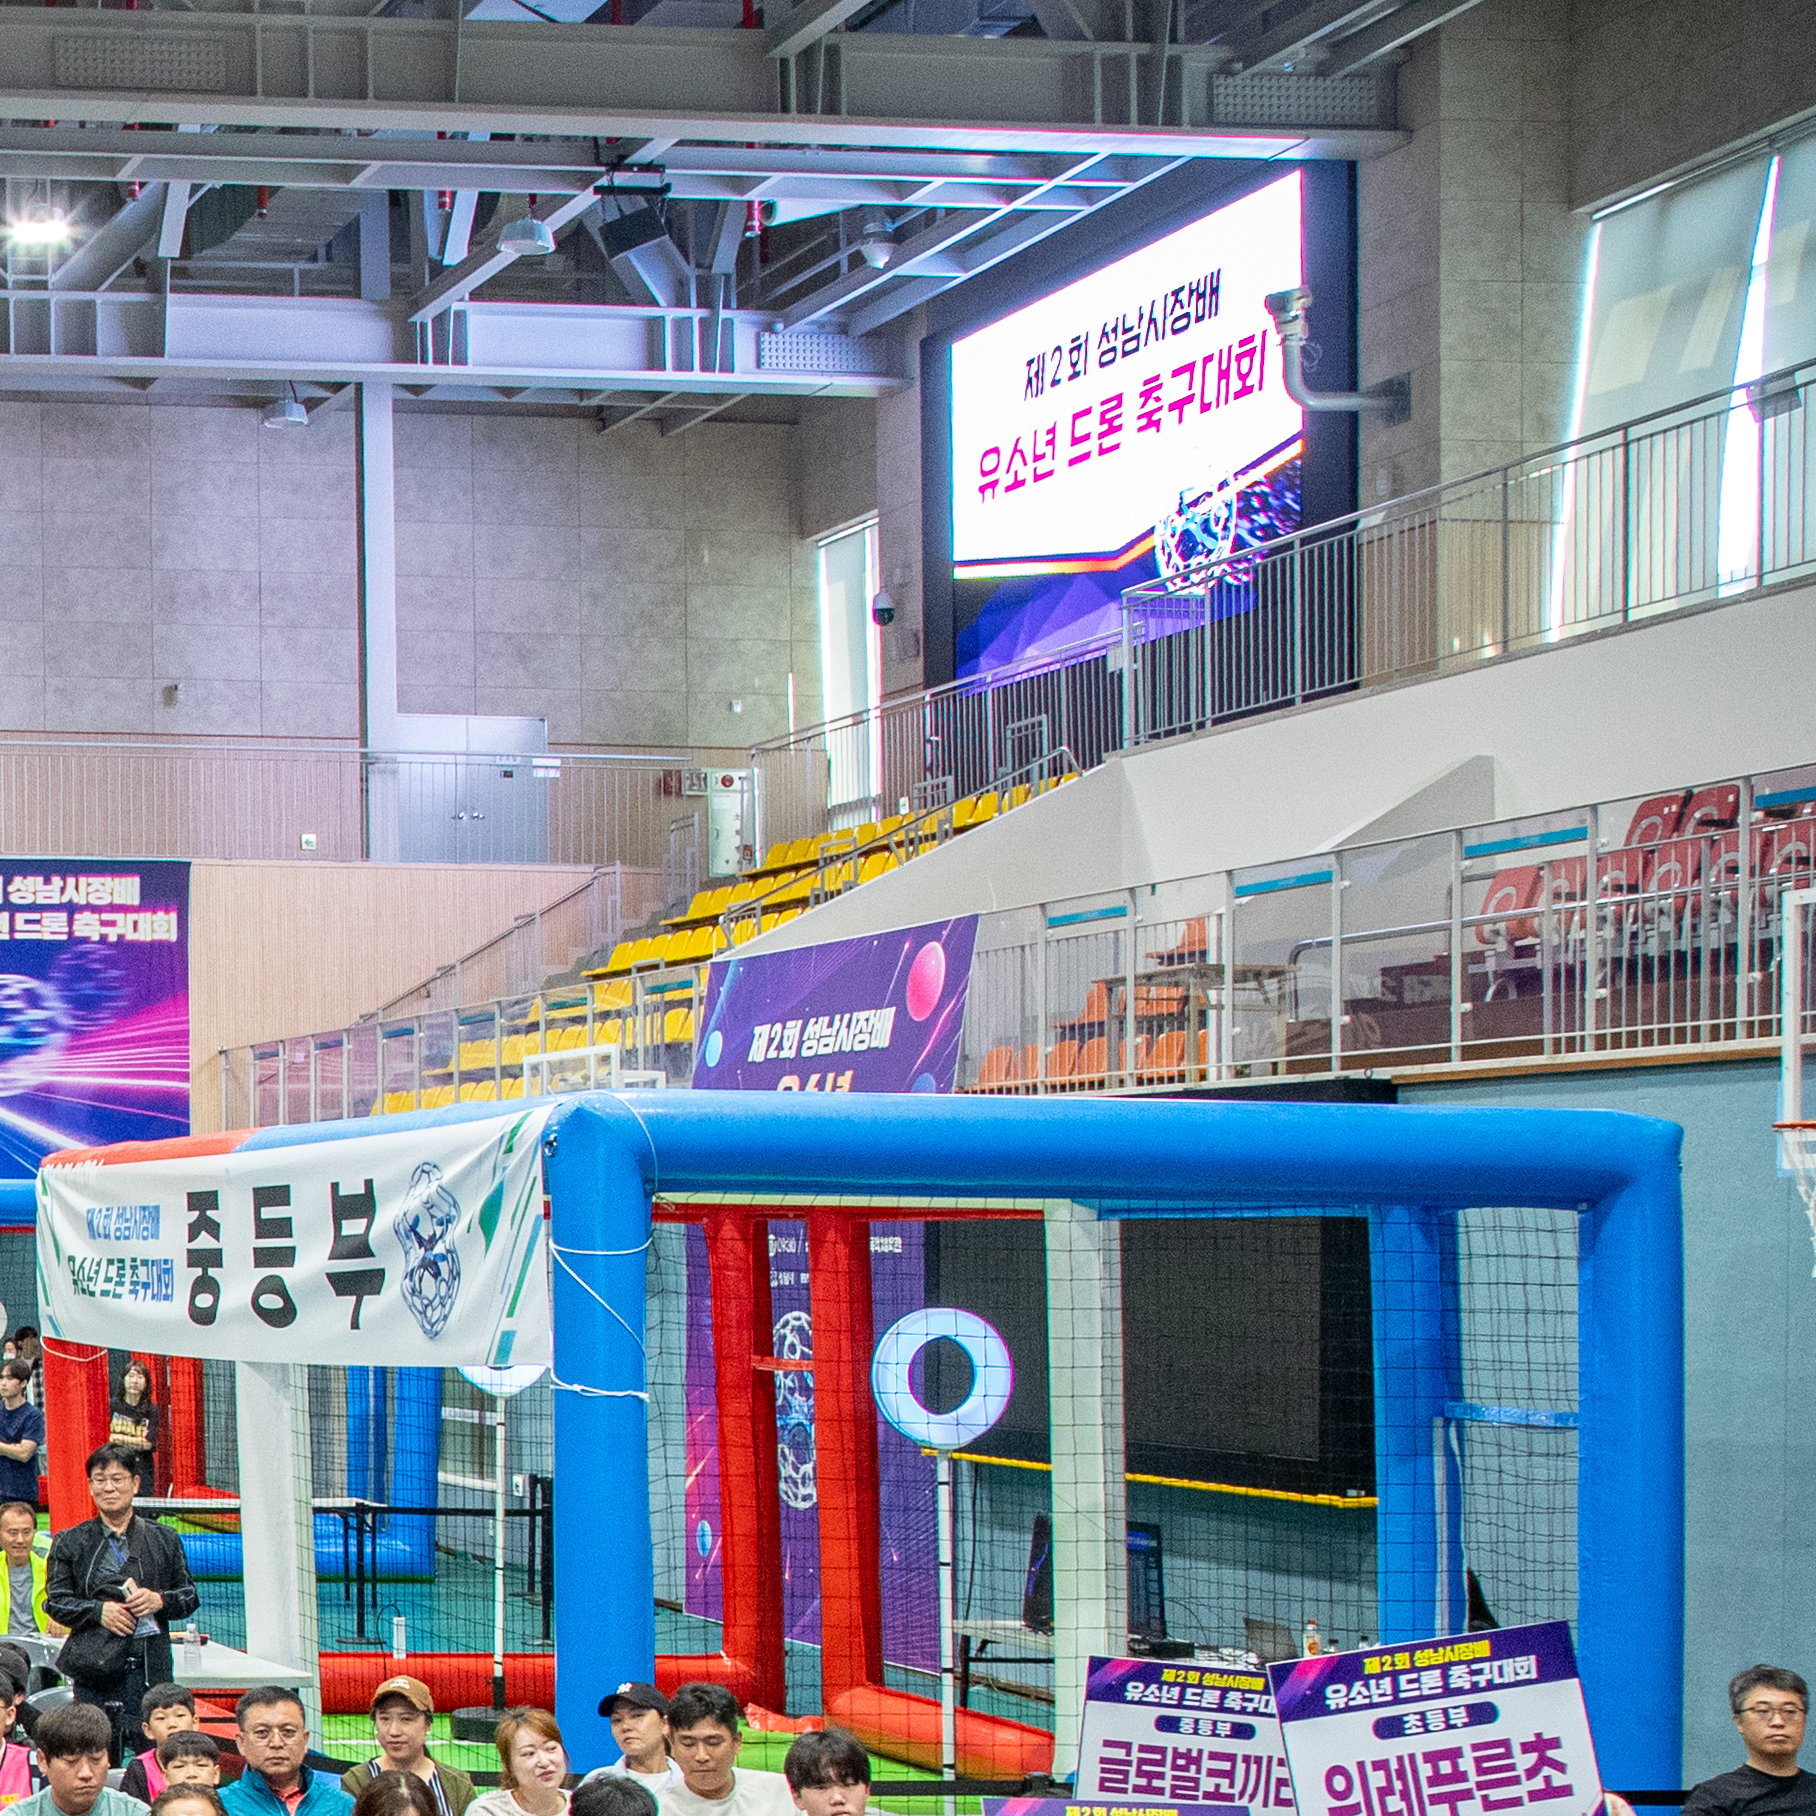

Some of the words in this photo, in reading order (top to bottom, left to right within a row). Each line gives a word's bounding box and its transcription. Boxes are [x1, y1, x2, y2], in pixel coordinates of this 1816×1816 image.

[1024, 332, 1089, 401] 제2회
[1097, 268, 1221, 368] 성남시장배
[978, 421, 1057, 503] 유소년
[1068, 392, 1124, 467] 드론
[1137, 329, 1267, 433] 축구대회
[7, 875, 140, 905] 성남시장배
[14, 911, 68, 940] 드론
[73, 910, 177, 942] 축구대회
[747, 1019, 801, 1062] 제2회
[801, 1006, 896, 1058] 성남시장배
[86, 1206, 111, 1241] 제2회
[114, 1204, 160, 1241] 성남시장배
[186, 1178, 385, 1330] 중등부
[67, 1254, 103, 1298] 유소년
[100, 1258, 127, 1298] 드론
[129, 1257, 174, 1303] 축구대회
[1363, 1656, 1411, 1674] 제2회
[1414, 1640, 1491, 1666] 성남시장배
[1125, 1681, 1180, 1705] 유소년
[1183, 1689, 1219, 1708] 드론
[1161, 1669, 1199, 1684] 제2회
[1202, 1673, 1265, 1691] 성남시장배
[1325, 1681, 1392, 1710] 유소년
[1397, 1670, 1443, 1697] 드론
[1448, 1655, 1537, 1689] 축구대회
[1403, 1706, 1469, 1735] 초등부
